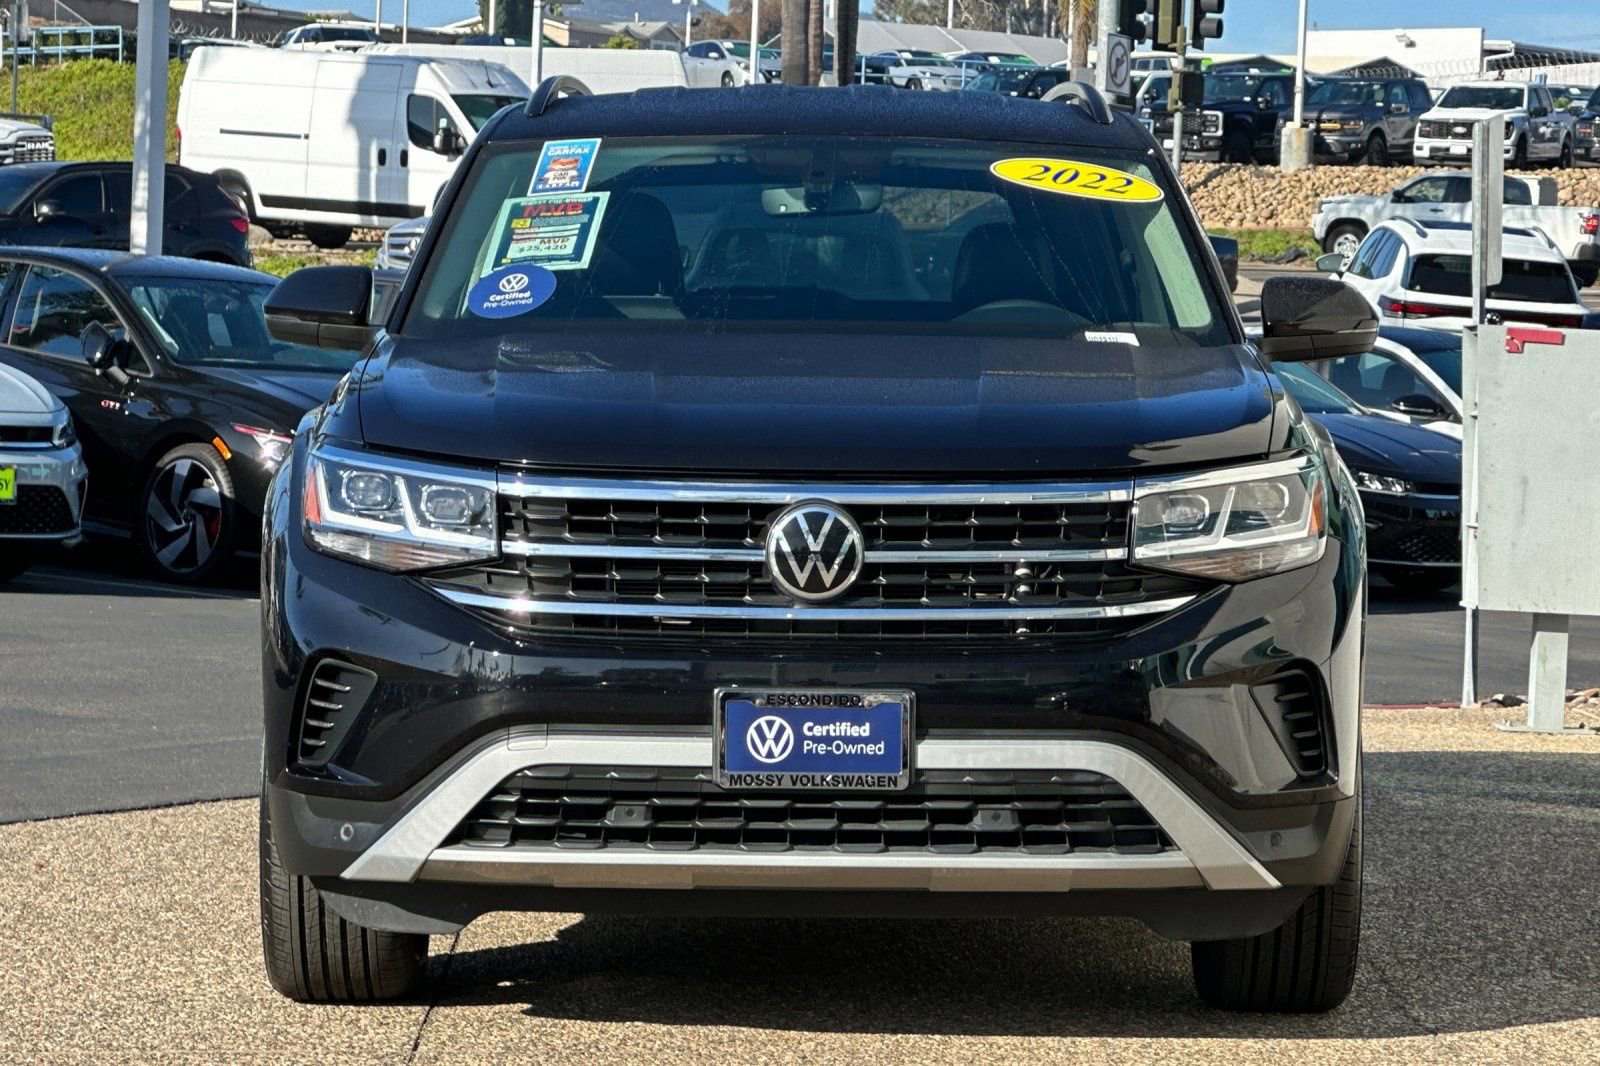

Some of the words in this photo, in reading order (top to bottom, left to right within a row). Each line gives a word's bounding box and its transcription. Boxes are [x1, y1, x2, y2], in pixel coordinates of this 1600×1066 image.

[27, 142, 49, 150] RAM
[547, 147, 590, 156] CARFAX
[1001, 164, 1134, 195] 2022
[523, 202, 583, 218] MVP
[539, 237, 571, 245] MVP
[517, 244, 568, 254] $25,420
[489, 290, 531, 302] Certified
[483, 297, 533, 309] Pre-Owned
[766, 693, 862, 707] ESCONDIDO
[803, 721, 870, 737] Certified
[803, 740, 885, 755] Pre-Owned
[729, 774, 784, 788] MOSSY
[790, 774, 899, 788] VOLKSWAGEN
